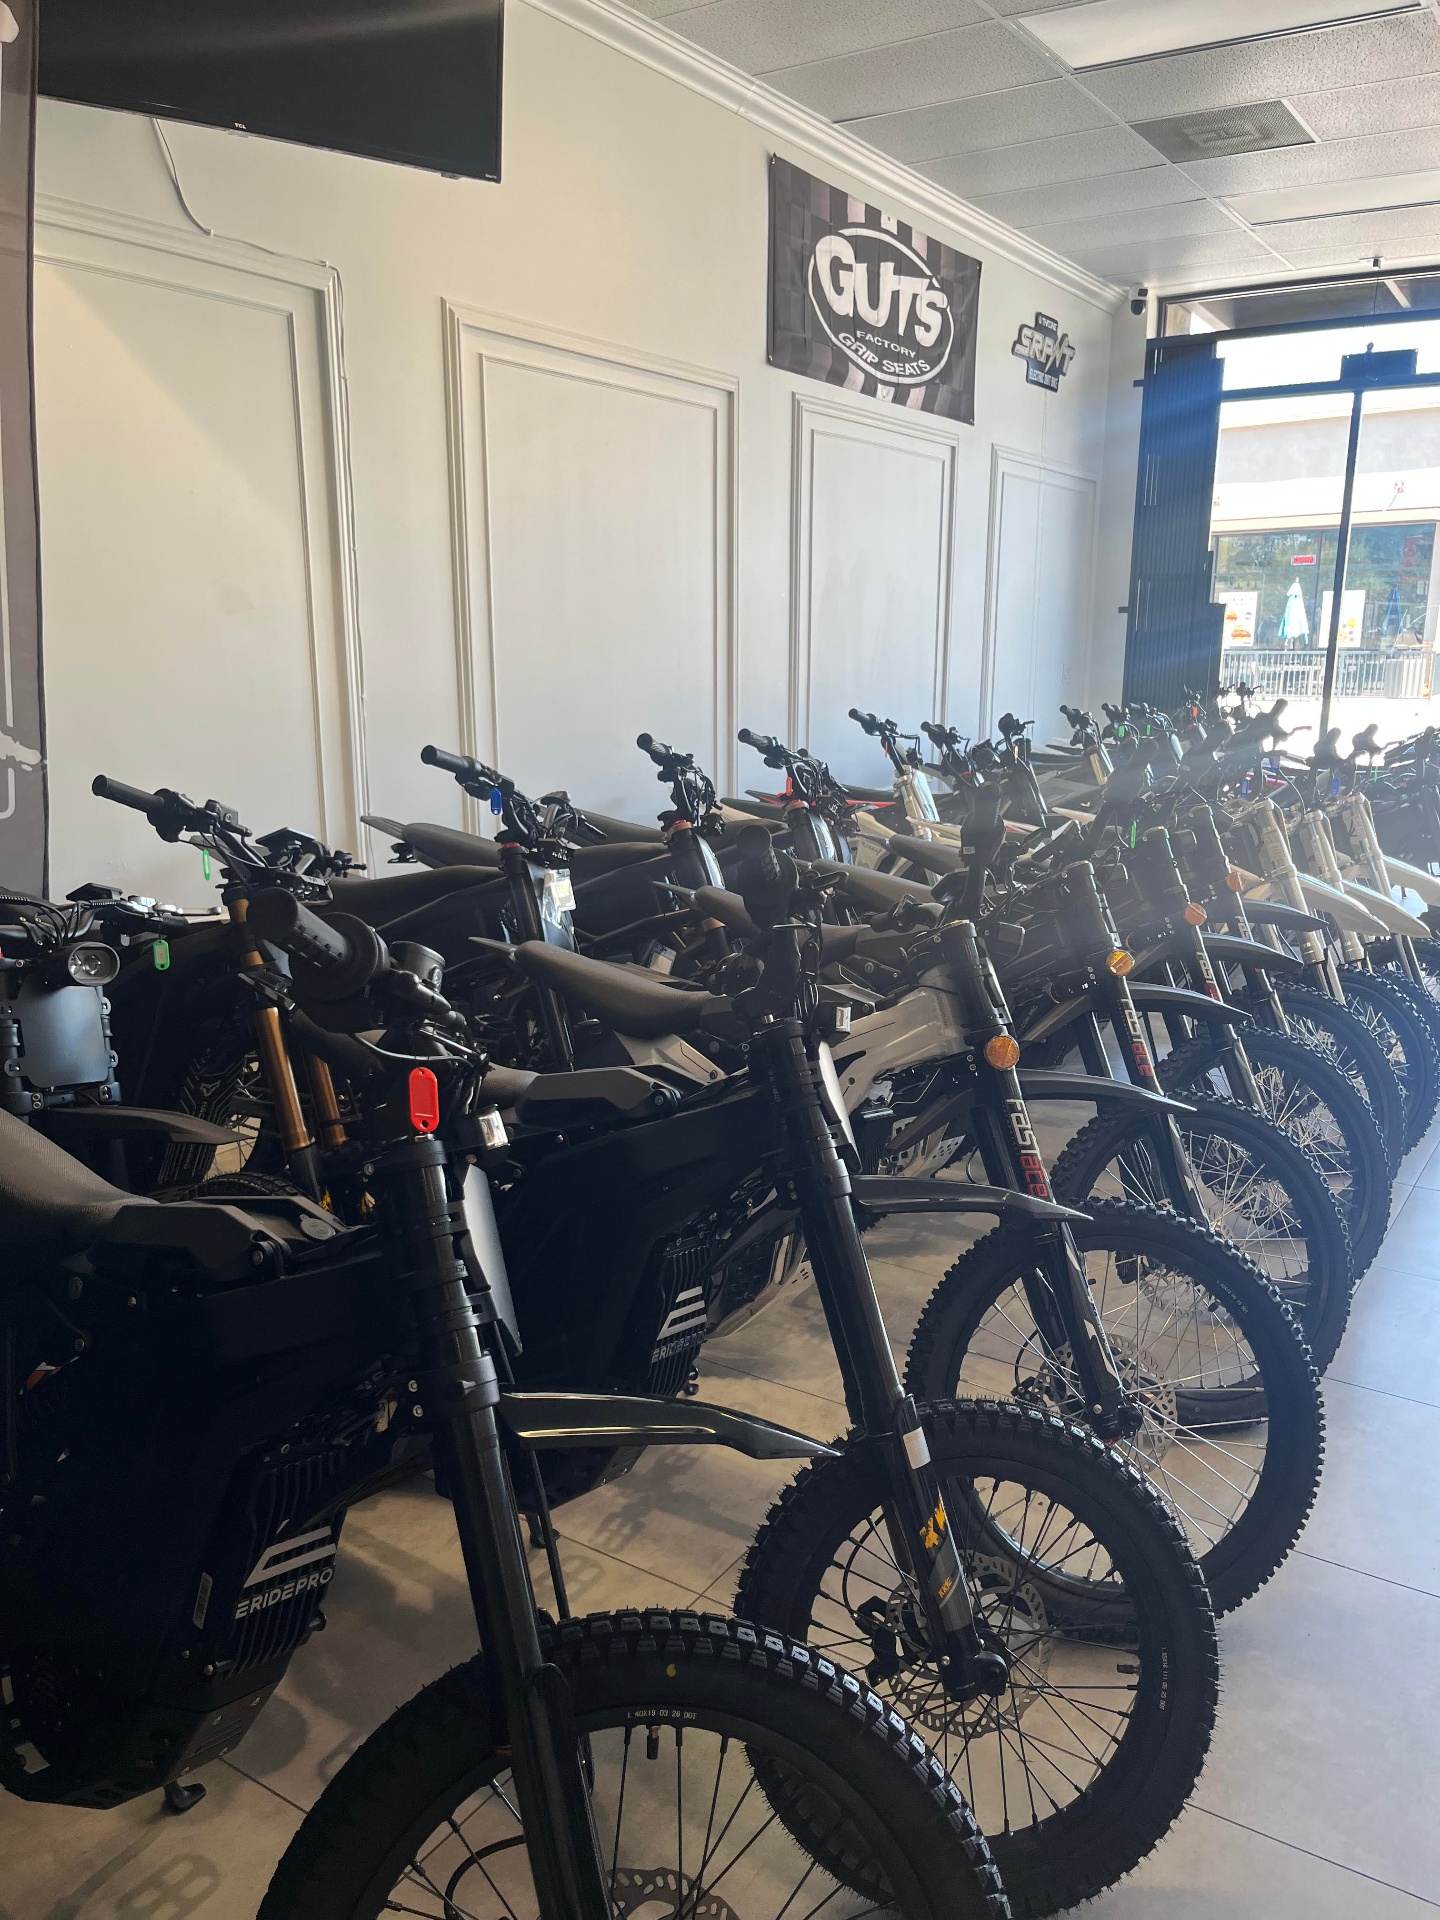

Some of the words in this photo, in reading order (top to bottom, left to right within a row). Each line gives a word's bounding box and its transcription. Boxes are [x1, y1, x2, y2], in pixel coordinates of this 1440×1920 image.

[234, 122, 247, 130] TCL
[815, 235, 948, 348] GUTS
[838, 332, 879, 364] GRIP
[882, 359, 931, 376] SEATS
[856, 330, 917, 359] FACTORY
[234, 1567, 334, 1620] ERIDEPRO
